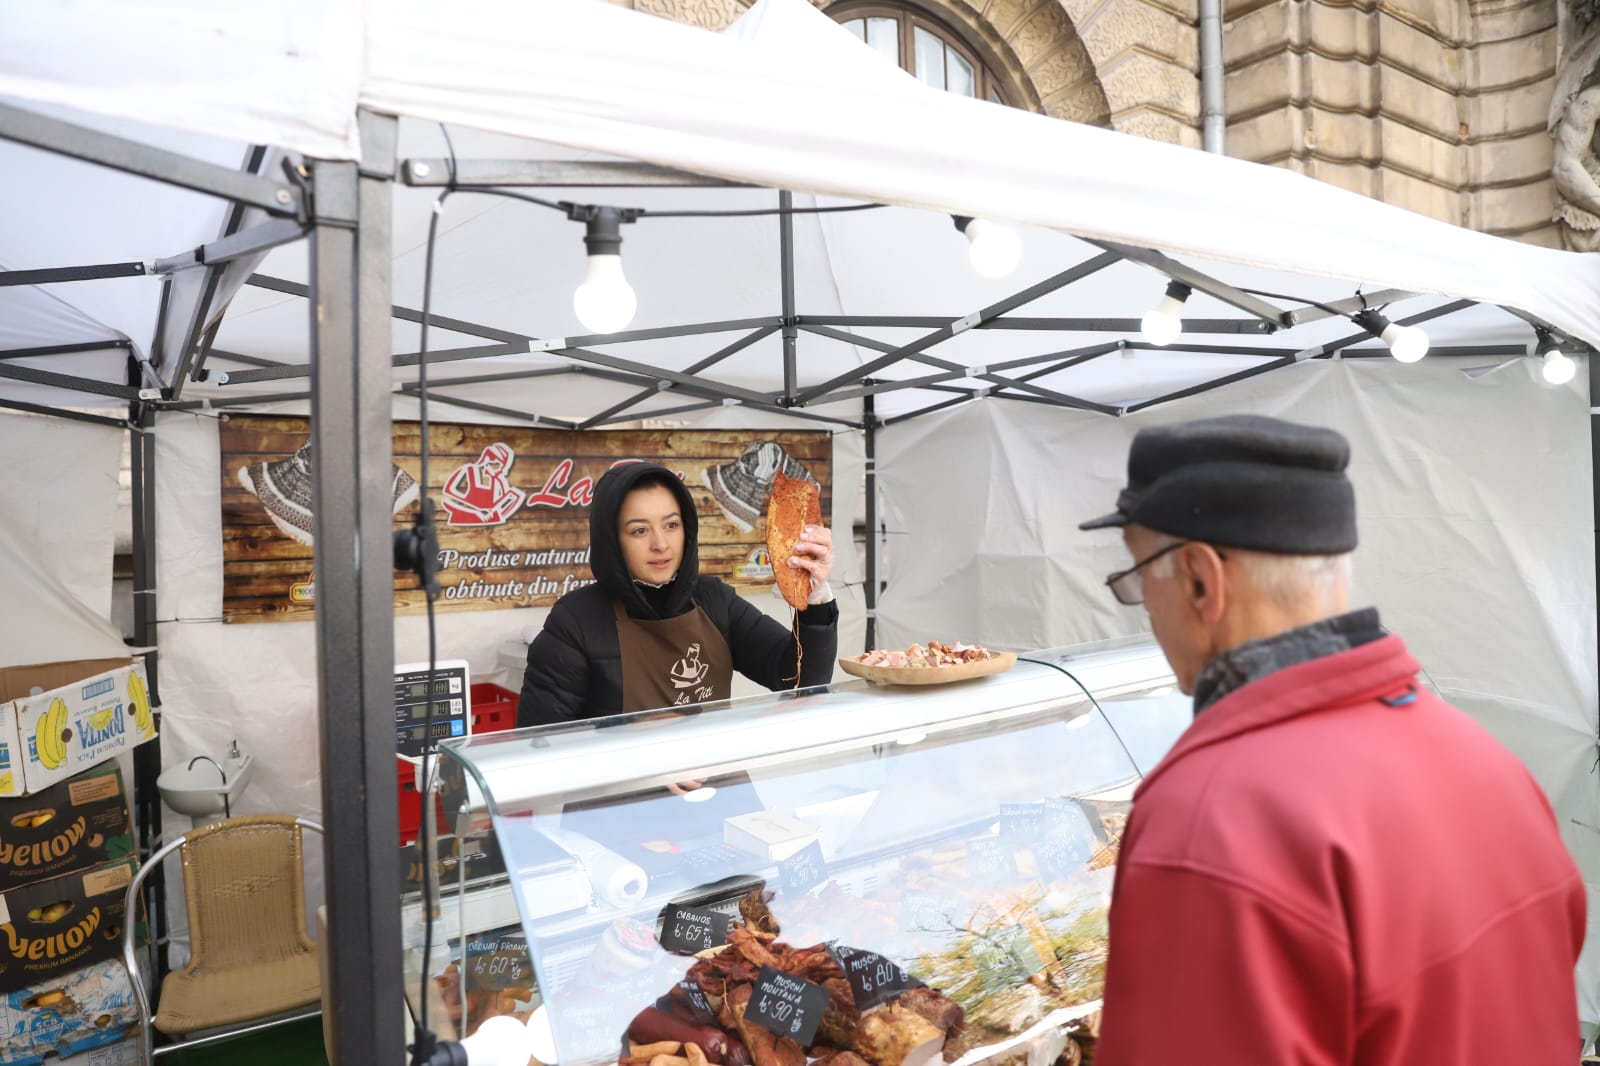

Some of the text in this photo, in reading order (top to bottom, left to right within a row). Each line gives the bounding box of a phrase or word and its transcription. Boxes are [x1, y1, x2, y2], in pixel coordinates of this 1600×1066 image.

[438, 543, 592, 569] Produse natural
[445, 579, 524, 600] obtinute
[527, 575, 558, 596] din
[674, 691, 691, 705] La
[75, 704, 125, 750] BONITA
[676, 910, 712, 925] CABANOS
[685, 924, 703, 941] 65
[24, 944, 93, 971] PREMIUM BANANAS
[488, 956, 509, 975] 60
[876, 961, 894, 987] 80
[760, 981, 803, 1005] MONTANA
[770, 1000, 793, 1022] 90
